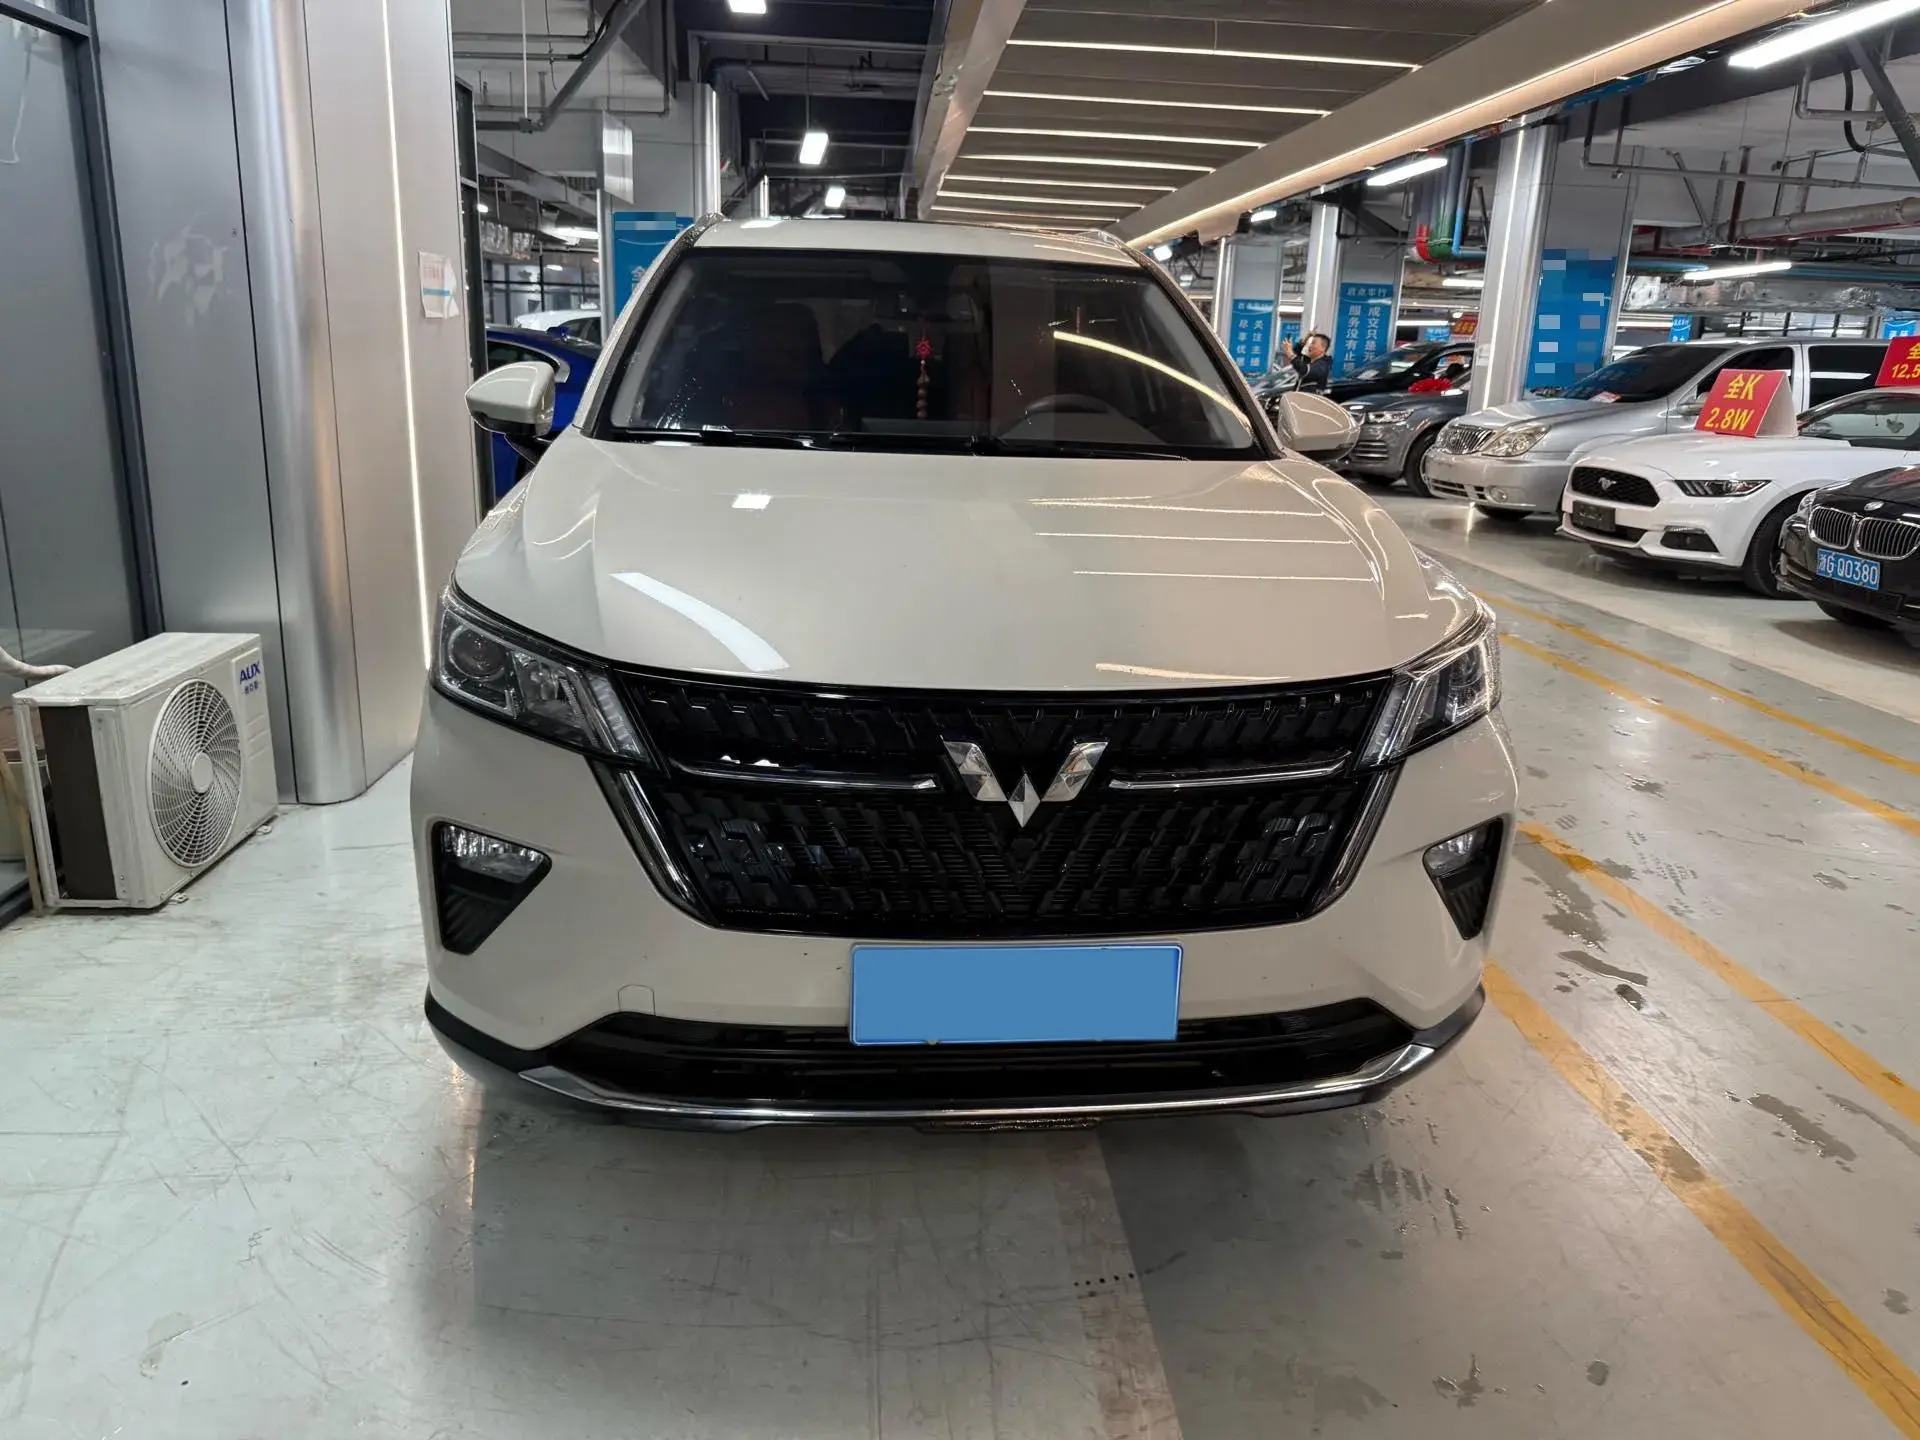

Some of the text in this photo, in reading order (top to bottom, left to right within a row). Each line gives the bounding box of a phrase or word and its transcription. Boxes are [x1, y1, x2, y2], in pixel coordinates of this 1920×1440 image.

[1723, 373, 1764, 400] 全K
[1704, 407, 1756, 431] 2.8W
[240, 660, 261, 684] AUX
